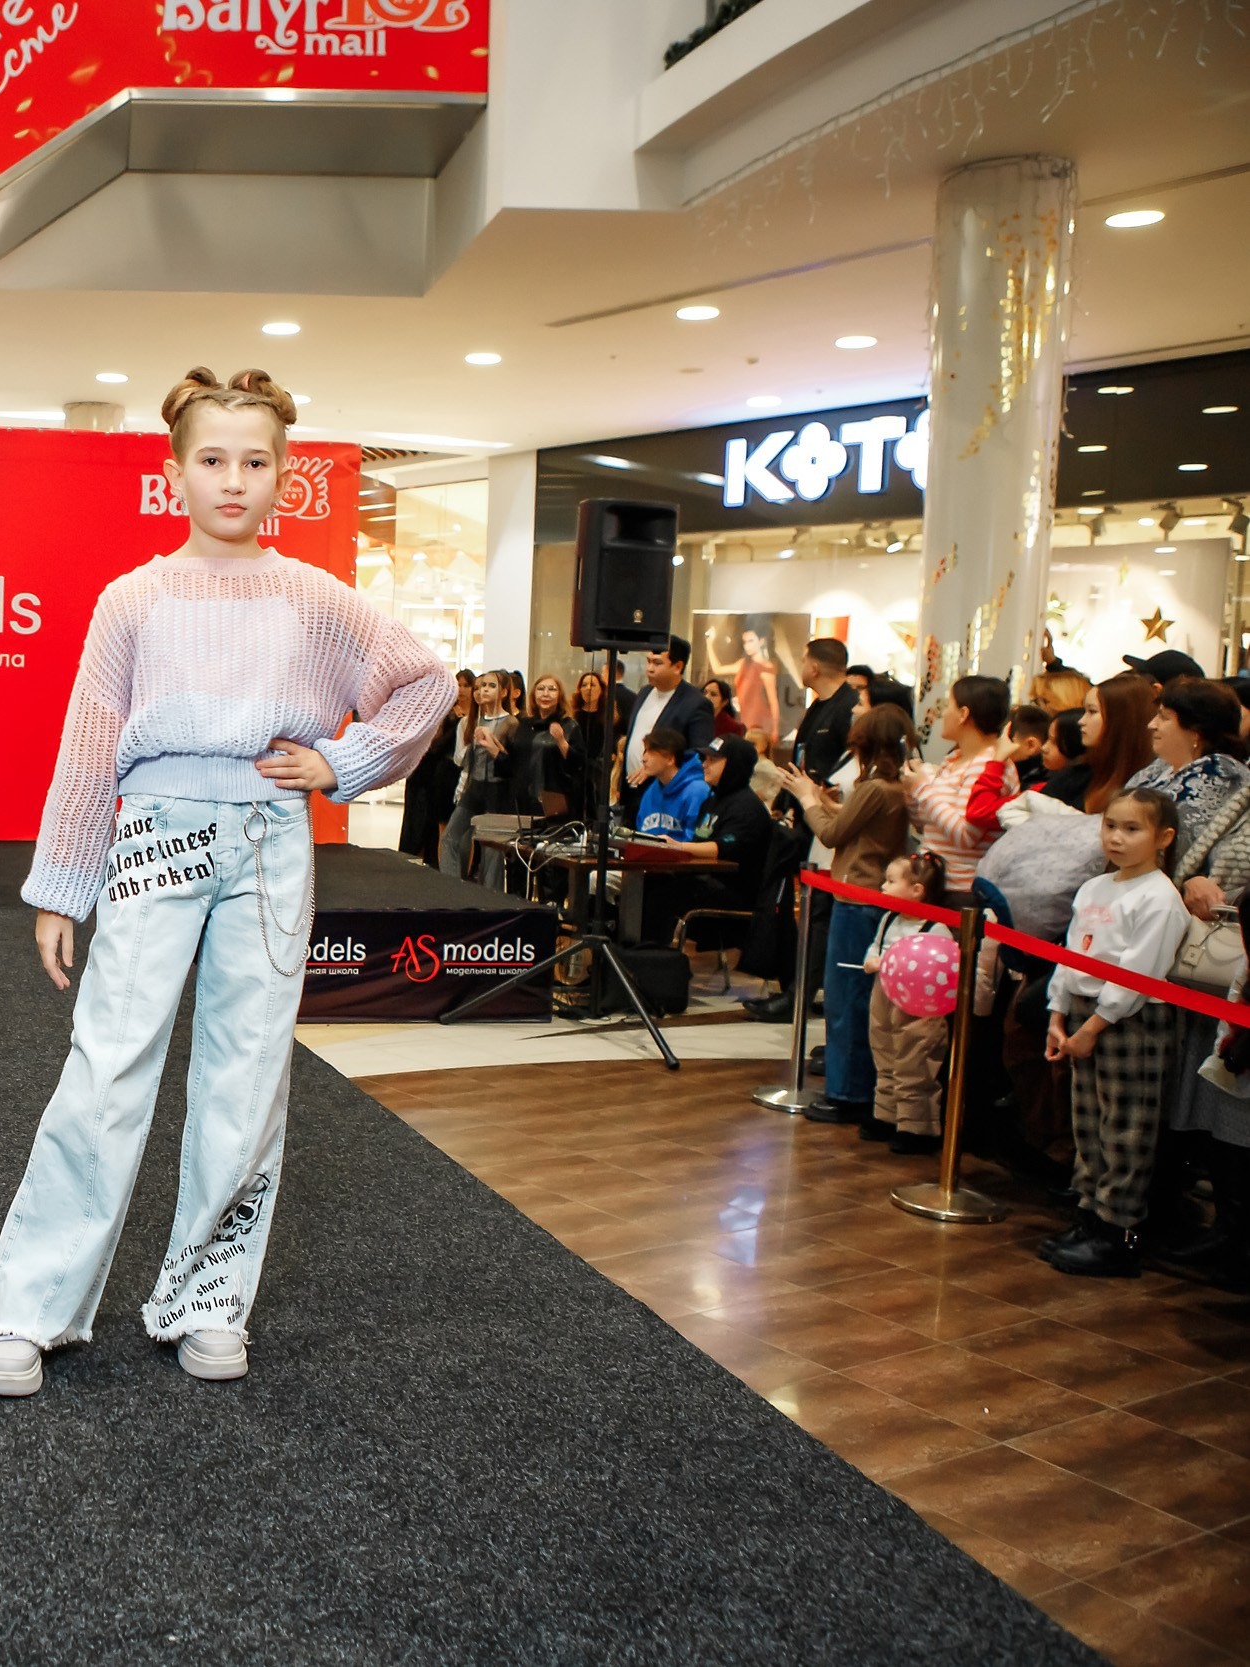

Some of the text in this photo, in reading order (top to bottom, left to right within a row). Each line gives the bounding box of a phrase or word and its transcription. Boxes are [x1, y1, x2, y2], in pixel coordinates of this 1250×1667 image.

[303, 30, 387, 57] mall
[390, 934, 535, 983] AS models
